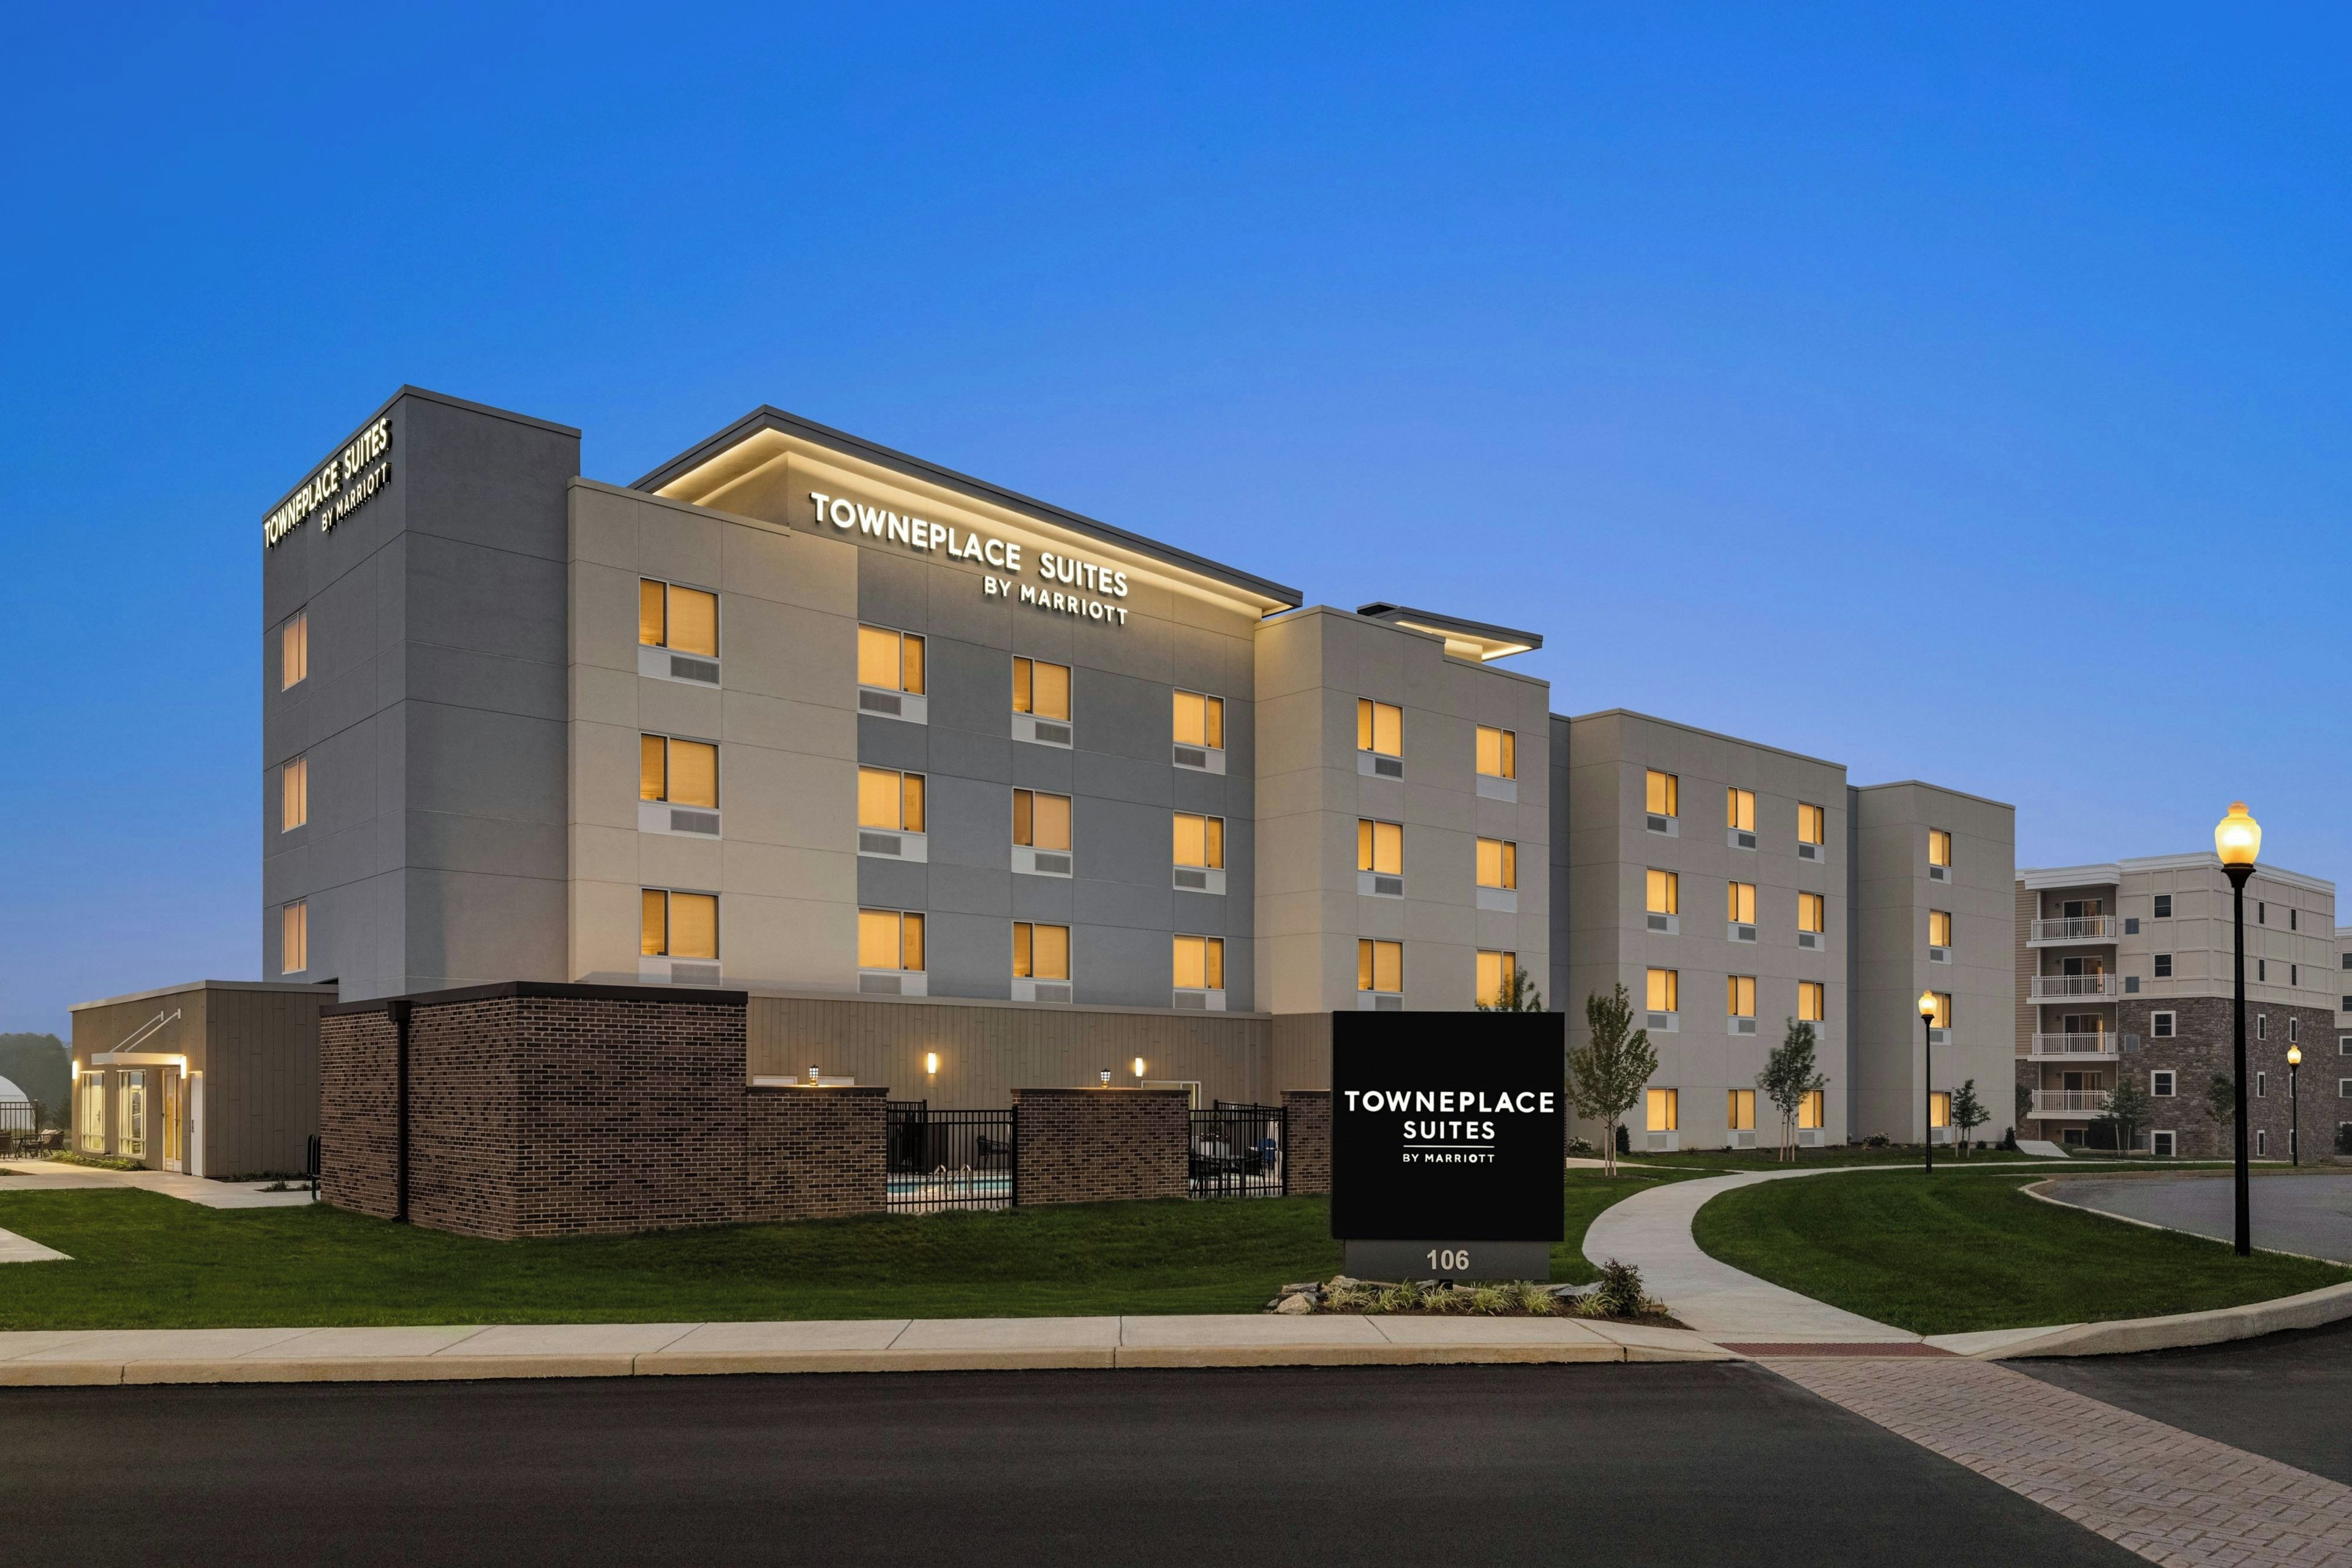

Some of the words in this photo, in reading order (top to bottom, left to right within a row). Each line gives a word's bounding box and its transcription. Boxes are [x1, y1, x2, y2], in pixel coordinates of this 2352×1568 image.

[264, 460, 339, 548] TOWNEPLACE
[344, 417, 388, 480] SUITES
[322, 507, 334, 532] BY
[336, 462, 388, 520] MARRIOTT
[810, 492, 1021, 571] TOWNEPLACE
[1040, 552, 1128, 597] SUITES
[982, 576, 1012, 597] BY
[1019, 584, 1128, 625] MARRIOTT
[1344, 1090, 1555, 1113] TOWNEPLACE
[1403, 1120, 1495, 1140] SUITES
[1403, 1153, 1419, 1163] BY
[1425, 1153, 1495, 1163] MARRIOTT
[1427, 1249, 1469, 1271] 106
